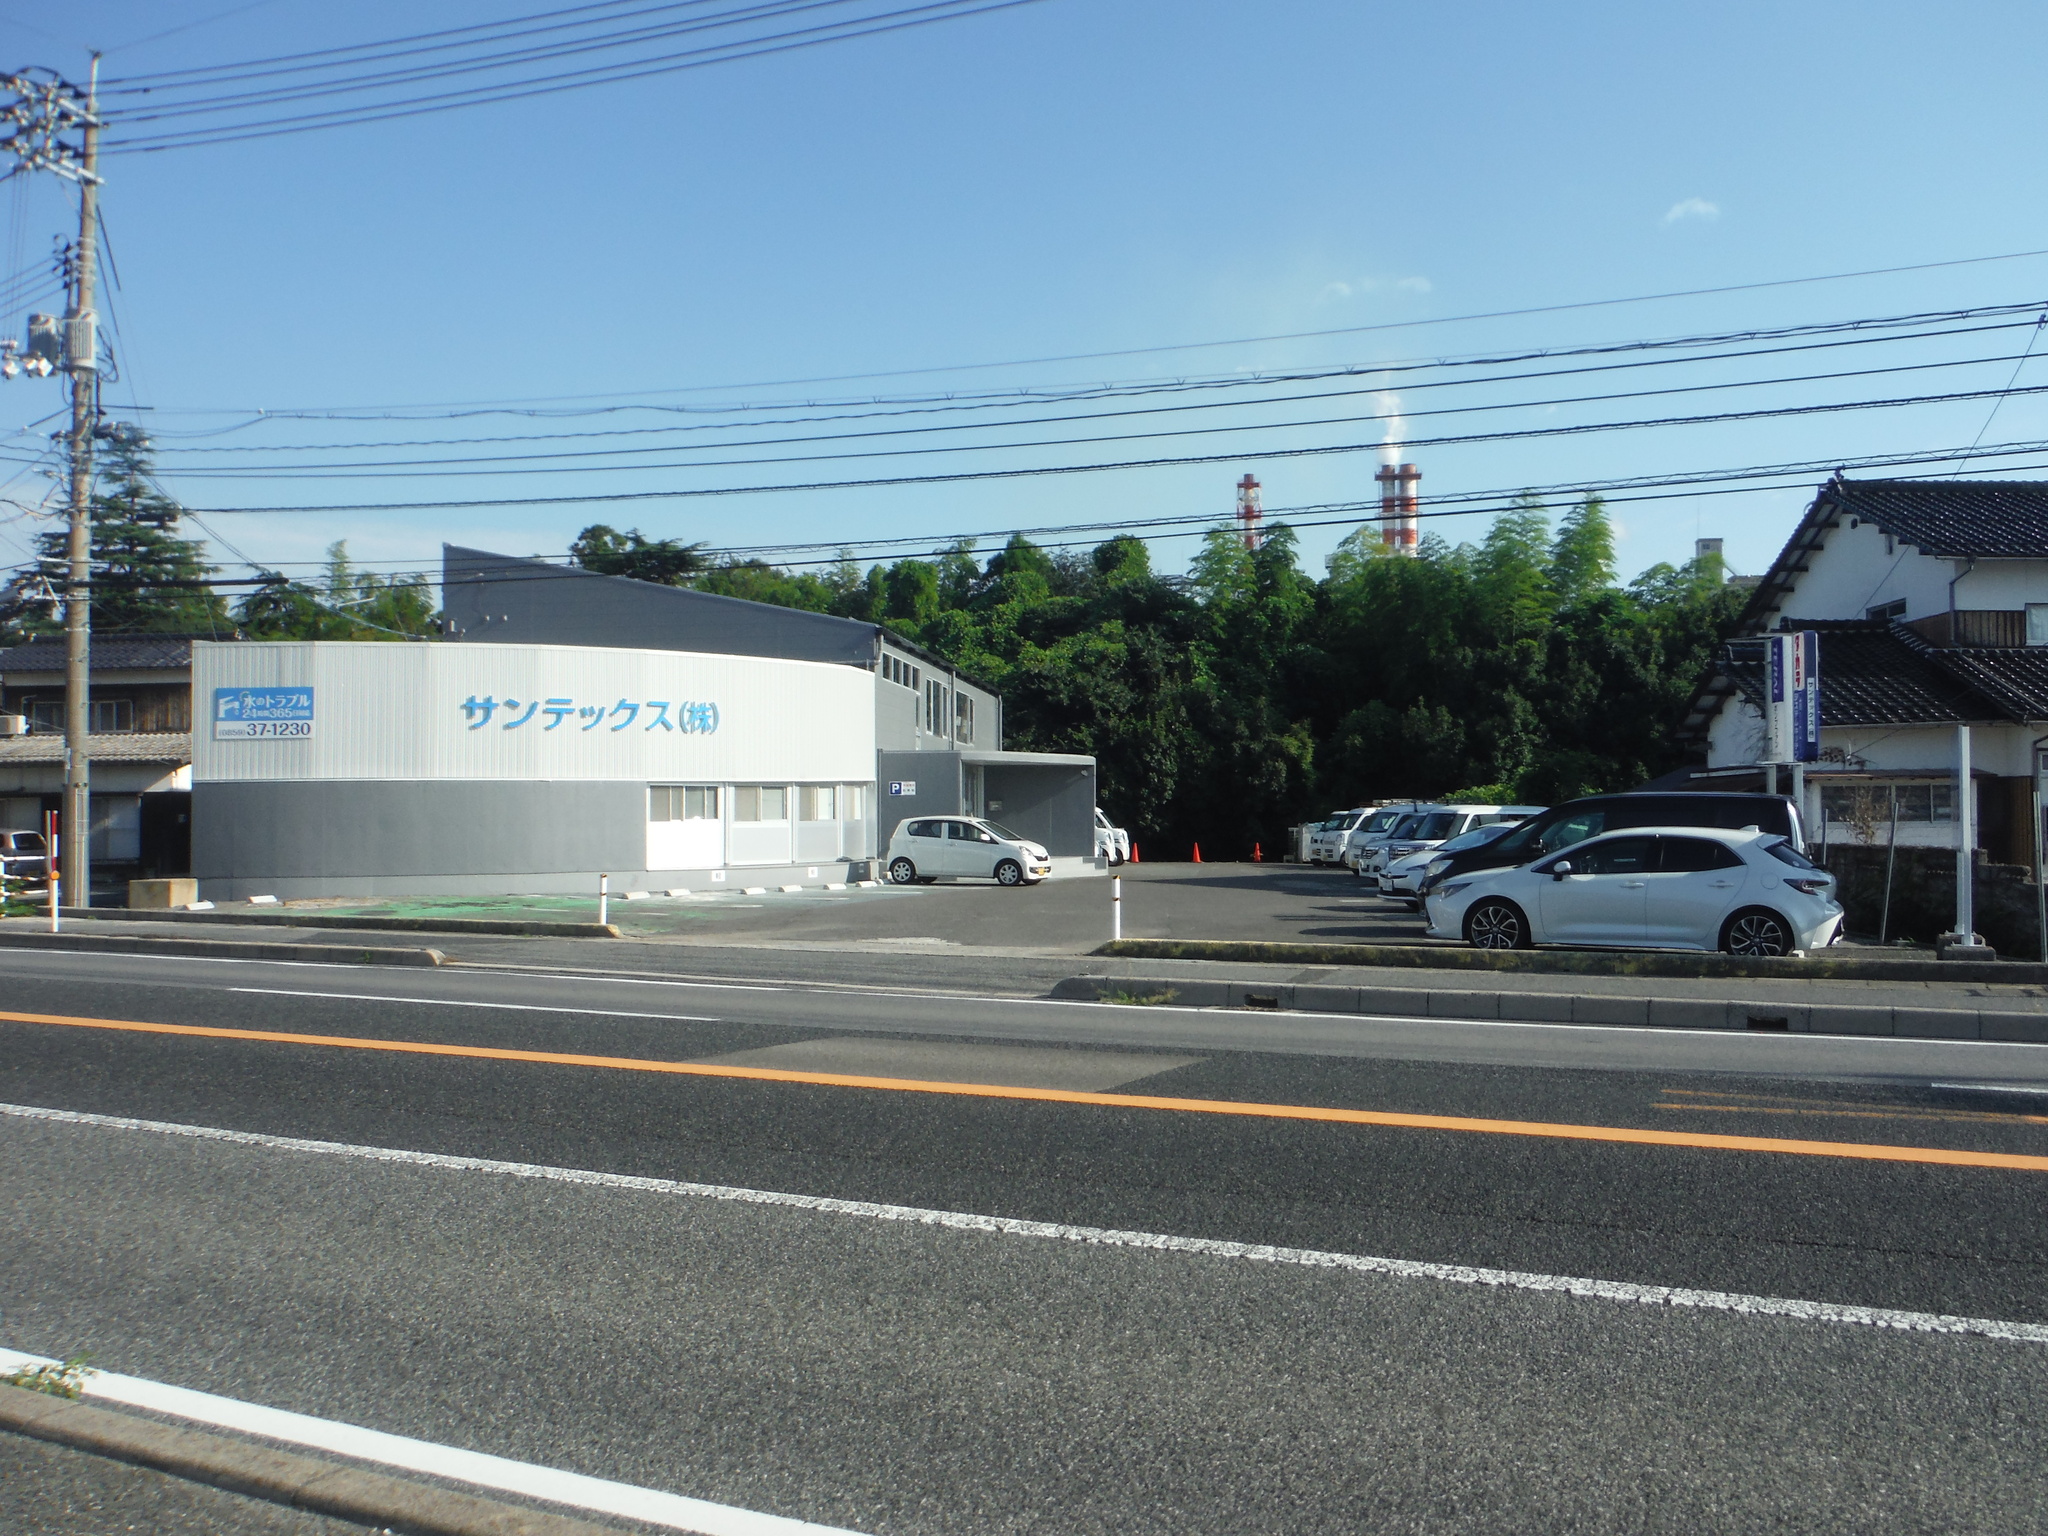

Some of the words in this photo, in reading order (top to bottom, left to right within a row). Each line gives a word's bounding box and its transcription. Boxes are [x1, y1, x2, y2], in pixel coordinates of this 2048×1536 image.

[243, 693, 311, 709] 水のトラブル
[460, 695, 720, 735] サンテックス(株)
[246, 722, 311, 736] 37-1230
[891, 783, 900, 794] P
